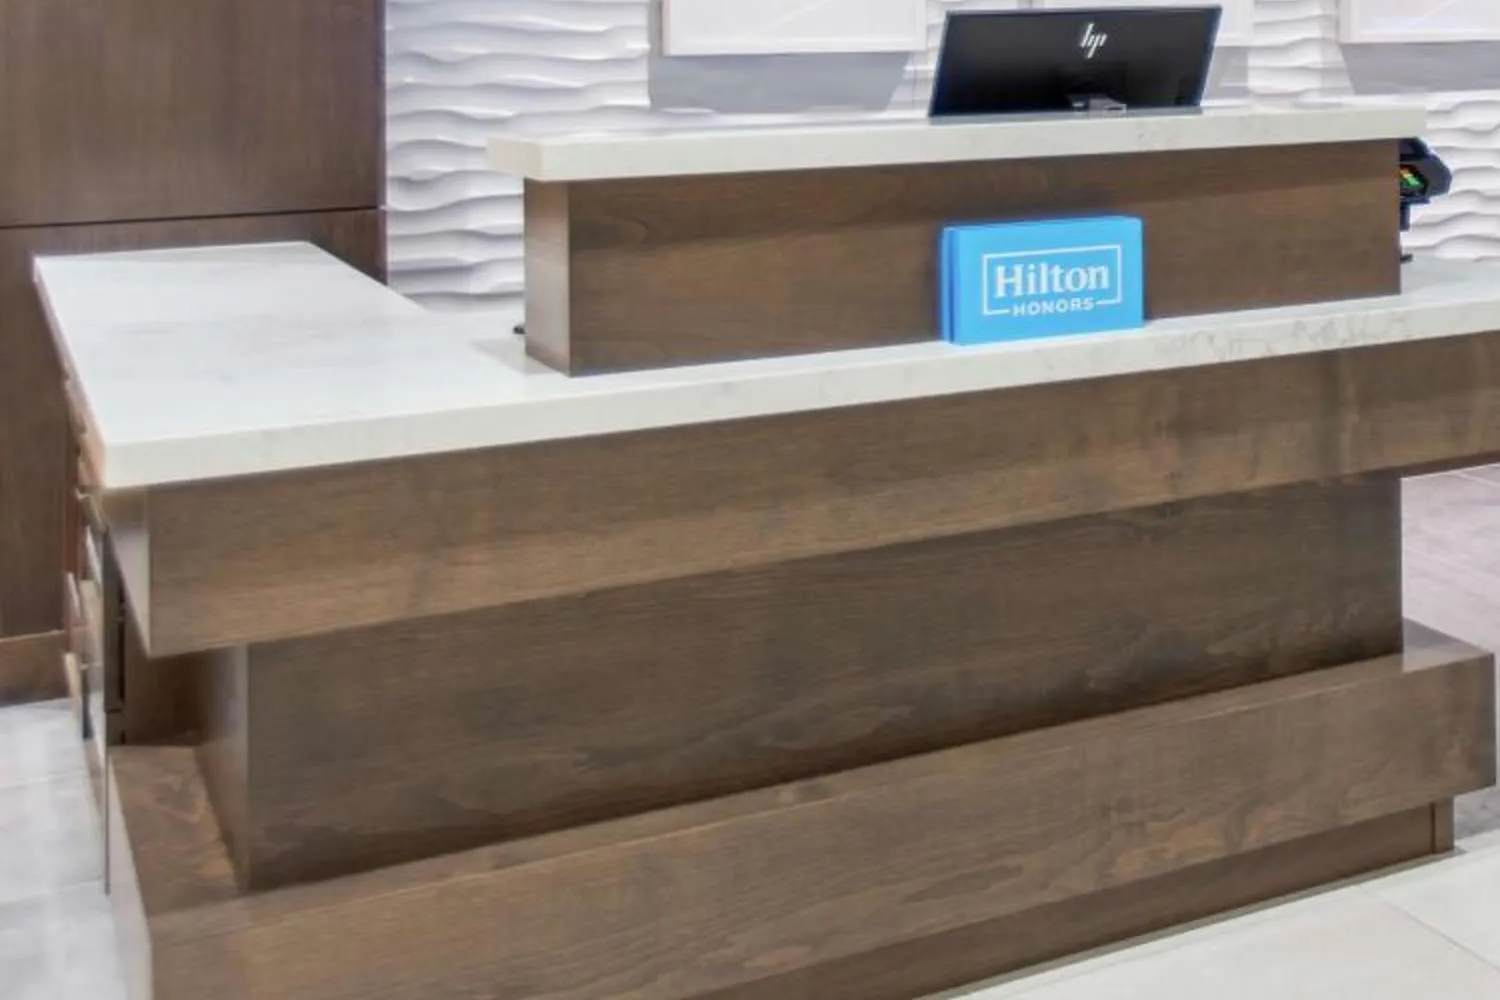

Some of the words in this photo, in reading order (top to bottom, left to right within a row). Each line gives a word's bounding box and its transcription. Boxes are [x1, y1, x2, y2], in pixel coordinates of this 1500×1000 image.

[1080, 22, 1107, 59] hp
[994, 261, 1110, 299] Hilton
[1012, 297, 1095, 317] HONORS
